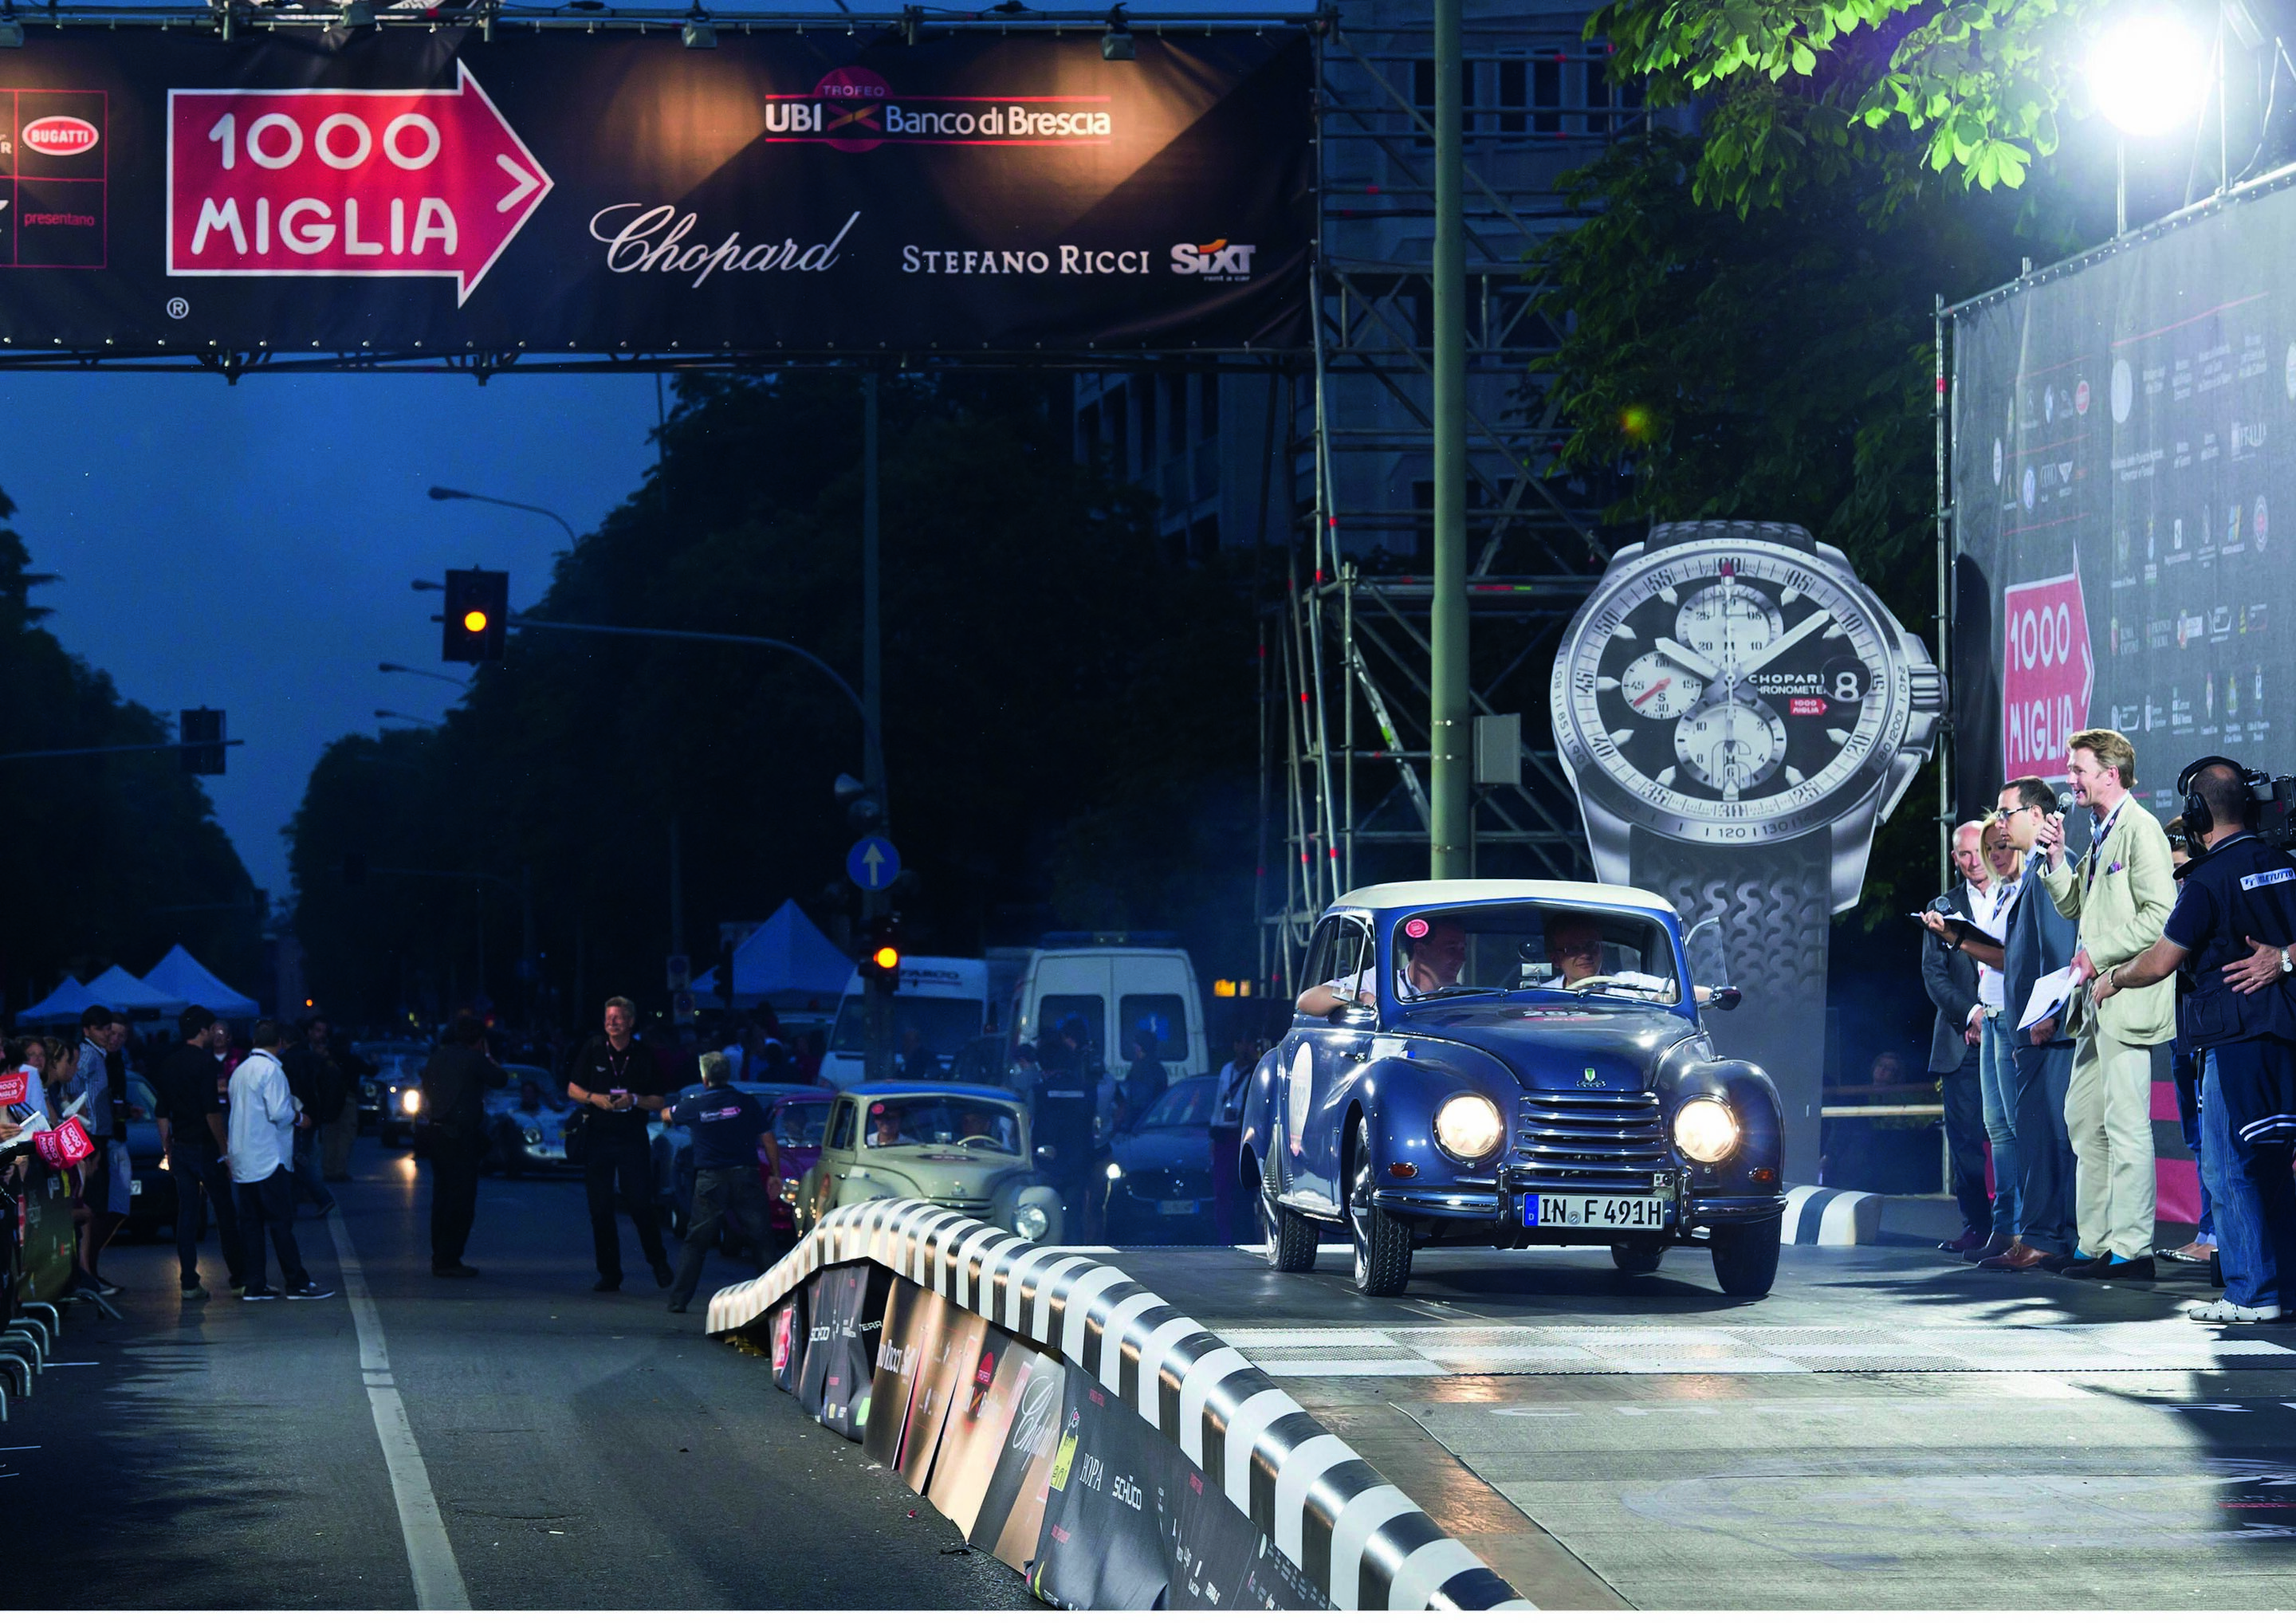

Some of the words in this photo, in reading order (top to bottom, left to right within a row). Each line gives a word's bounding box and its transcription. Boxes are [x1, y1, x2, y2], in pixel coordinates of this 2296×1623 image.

[822, 84, 886, 97] TROFEO
[765, 103, 822, 132] UBI
[886, 105, 976, 135] Banco
[978, 106, 1004, 135] di
[1008, 105, 1111, 136] Brescia
[30, 129, 89, 144] BUGATTI
[208, 112, 442, 171] 1000
[24, 213, 95, 227] presentano
[191, 196, 458, 256] MIGLIA
[588, 202, 861, 289] Chopard
[902, 244, 1050, 275] STEFANO
[1058, 244, 1150, 275] RICCI
[2010, 601, 2070, 672] 1000
[1757, 686, 1827, 695] HRONOMETE
[1834, 671, 1860, 702] 8
[2009, 694, 2074, 764] MIGLIA
[1719, 827, 1746, 838] 120
[1762, 821, 1789, 835] 130
[1540, 1198, 1567, 1224] IN
[1584, 1199, 1598, 1224] F
[1604, 1199, 1662, 1225] 491H
[1079, 1452, 1104, 1491] HOPA
